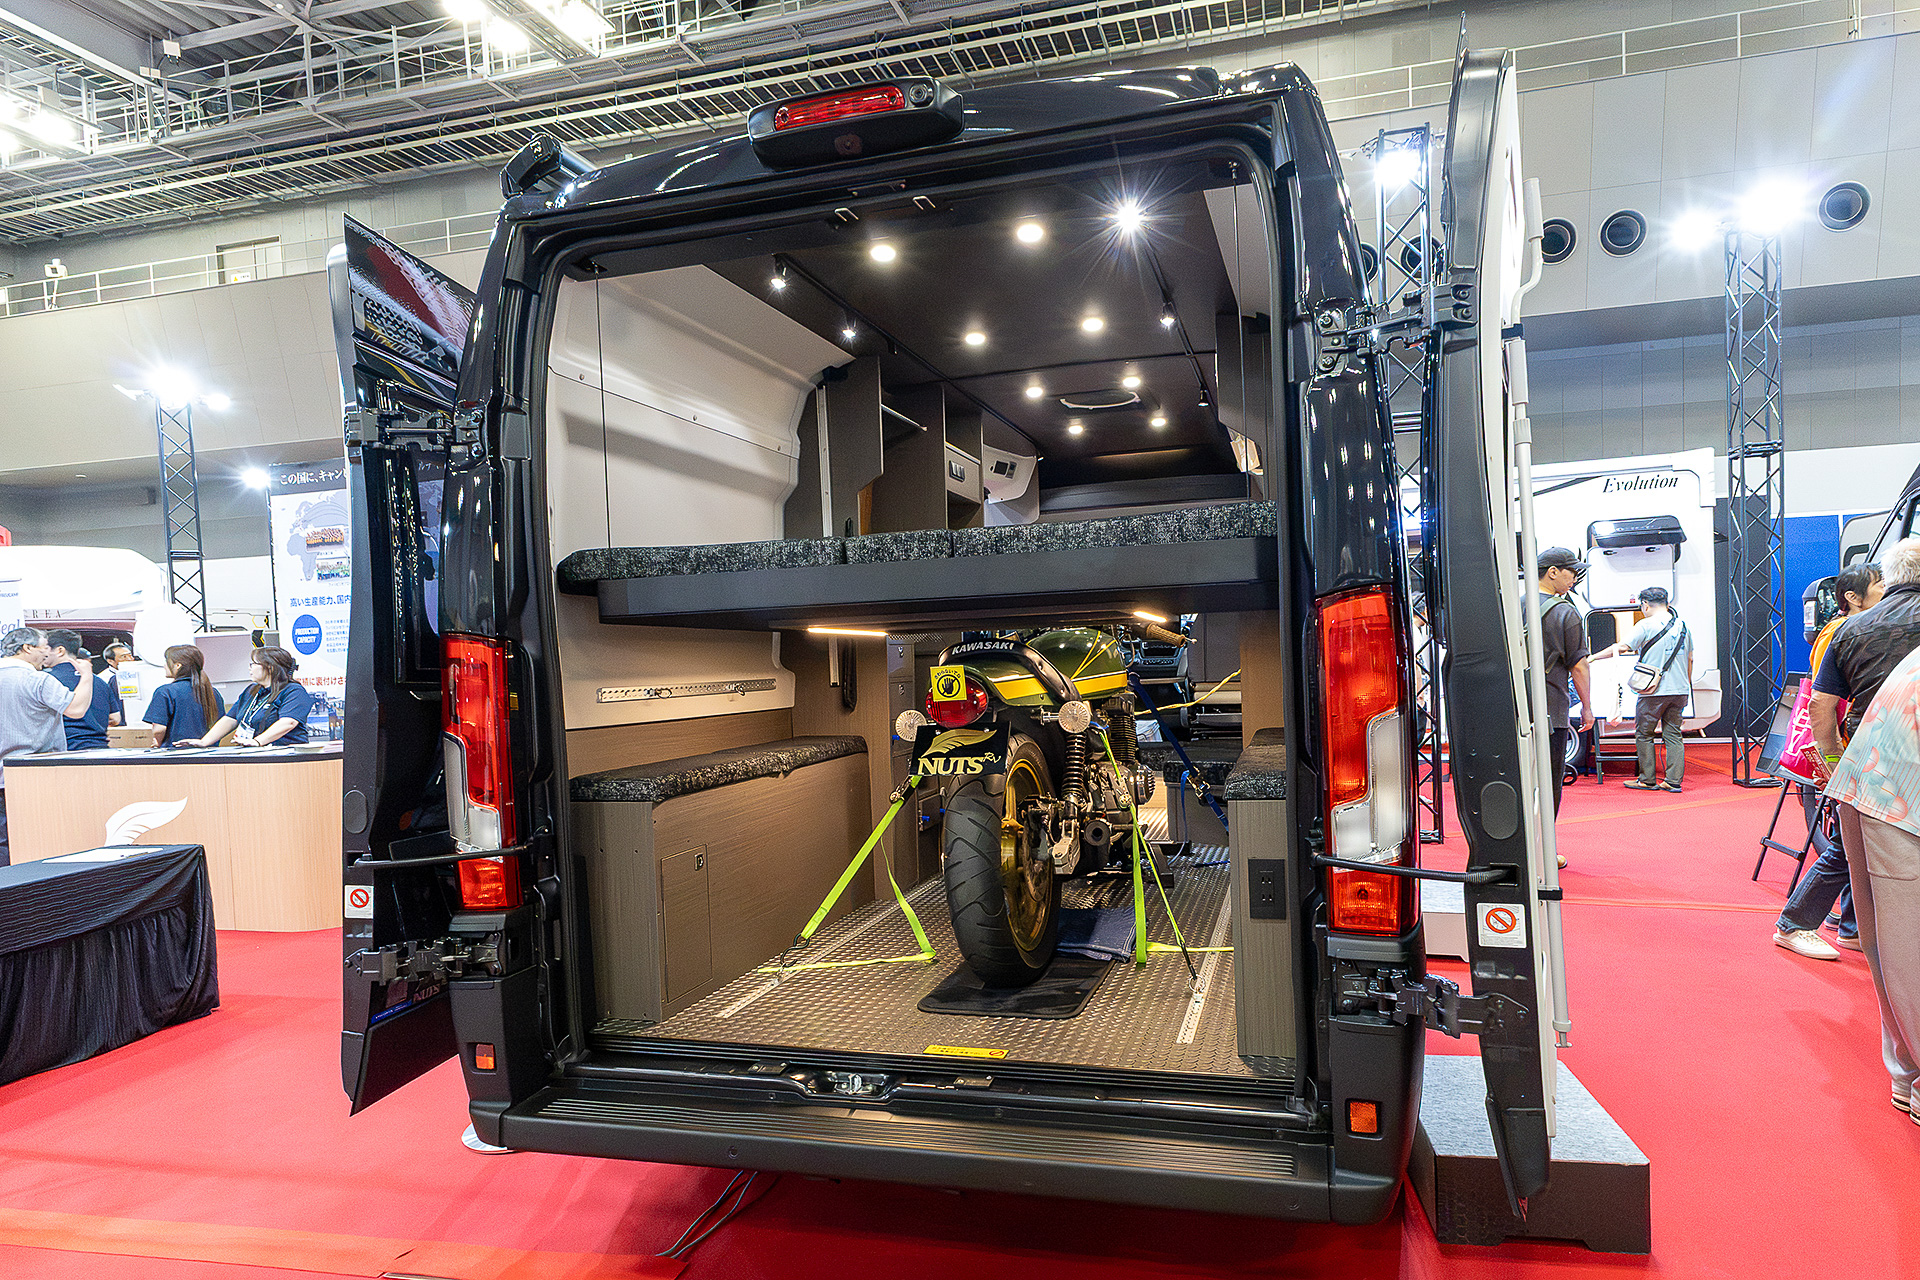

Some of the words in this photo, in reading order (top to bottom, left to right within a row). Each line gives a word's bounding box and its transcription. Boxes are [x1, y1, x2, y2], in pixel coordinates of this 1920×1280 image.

[1603, 474, 1679, 493] Evolution
[951, 641, 1014, 655] KAWASAKI
[917, 757, 984, 775] NUTS
